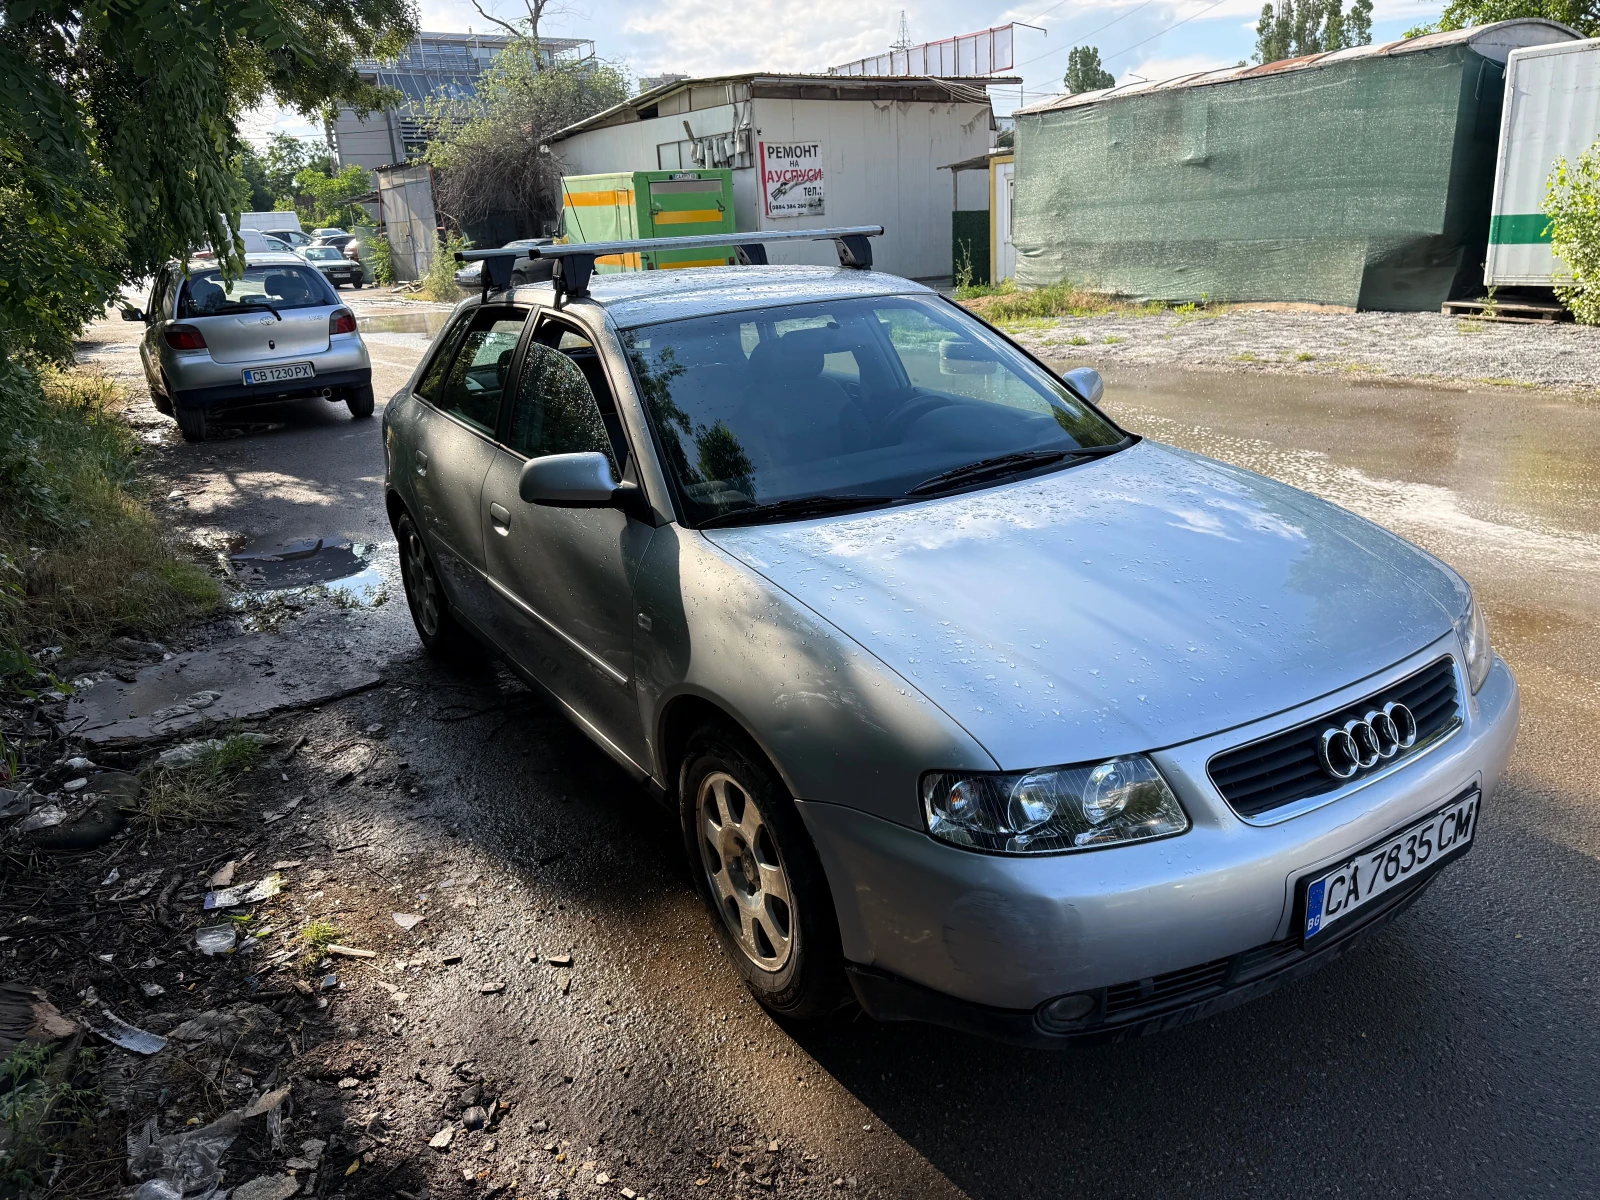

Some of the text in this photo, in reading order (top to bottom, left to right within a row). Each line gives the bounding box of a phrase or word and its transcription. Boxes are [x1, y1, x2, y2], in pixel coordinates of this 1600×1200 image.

[767, 145, 818, 159] РЕМОНТ
[789, 160, 800, 168] НА
[767, 168, 822, 183] АУСПУСИ
[252, 370, 268, 382] CB
[269, 367, 294, 380] 1230
[294, 365, 310, 377] PX
[1325, 800, 1475, 916] CA 7835 CM
[1307, 914, 1321, 931] BG
